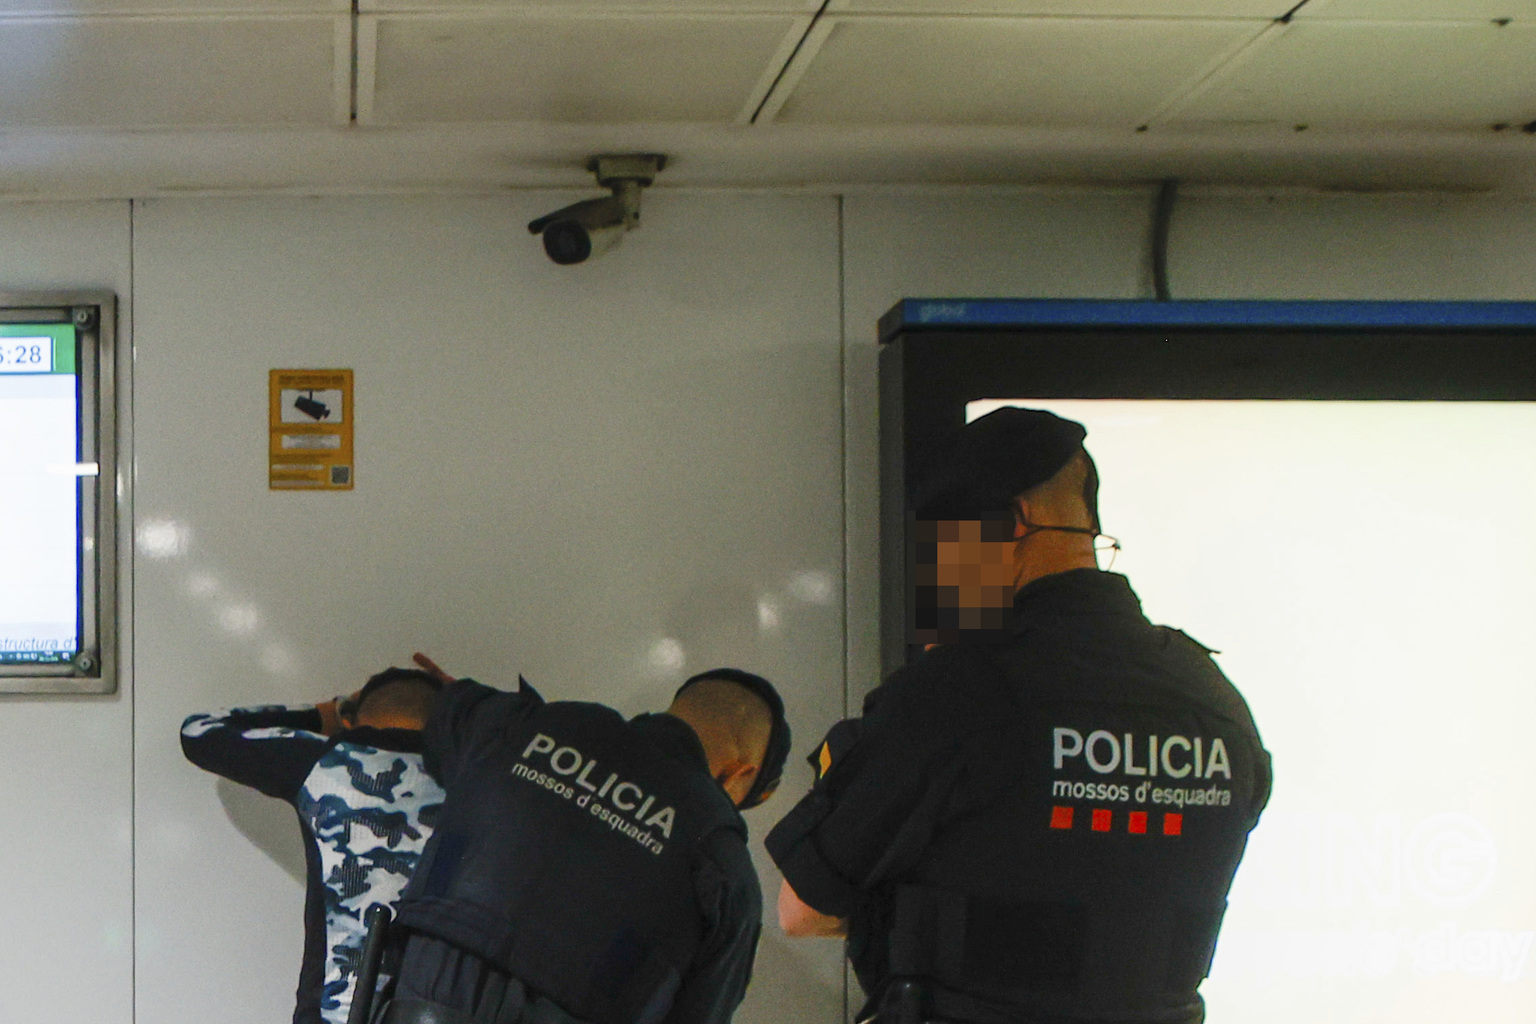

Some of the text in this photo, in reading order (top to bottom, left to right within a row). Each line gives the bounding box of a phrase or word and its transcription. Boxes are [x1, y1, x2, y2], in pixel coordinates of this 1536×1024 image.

[521, 733, 676, 839] POLICIA
[1053, 727, 1232, 780] POLICIA
[511, 762, 664, 856] mossos d'esquadra
[1052, 780, 1232, 809] mossos d'esquadra
